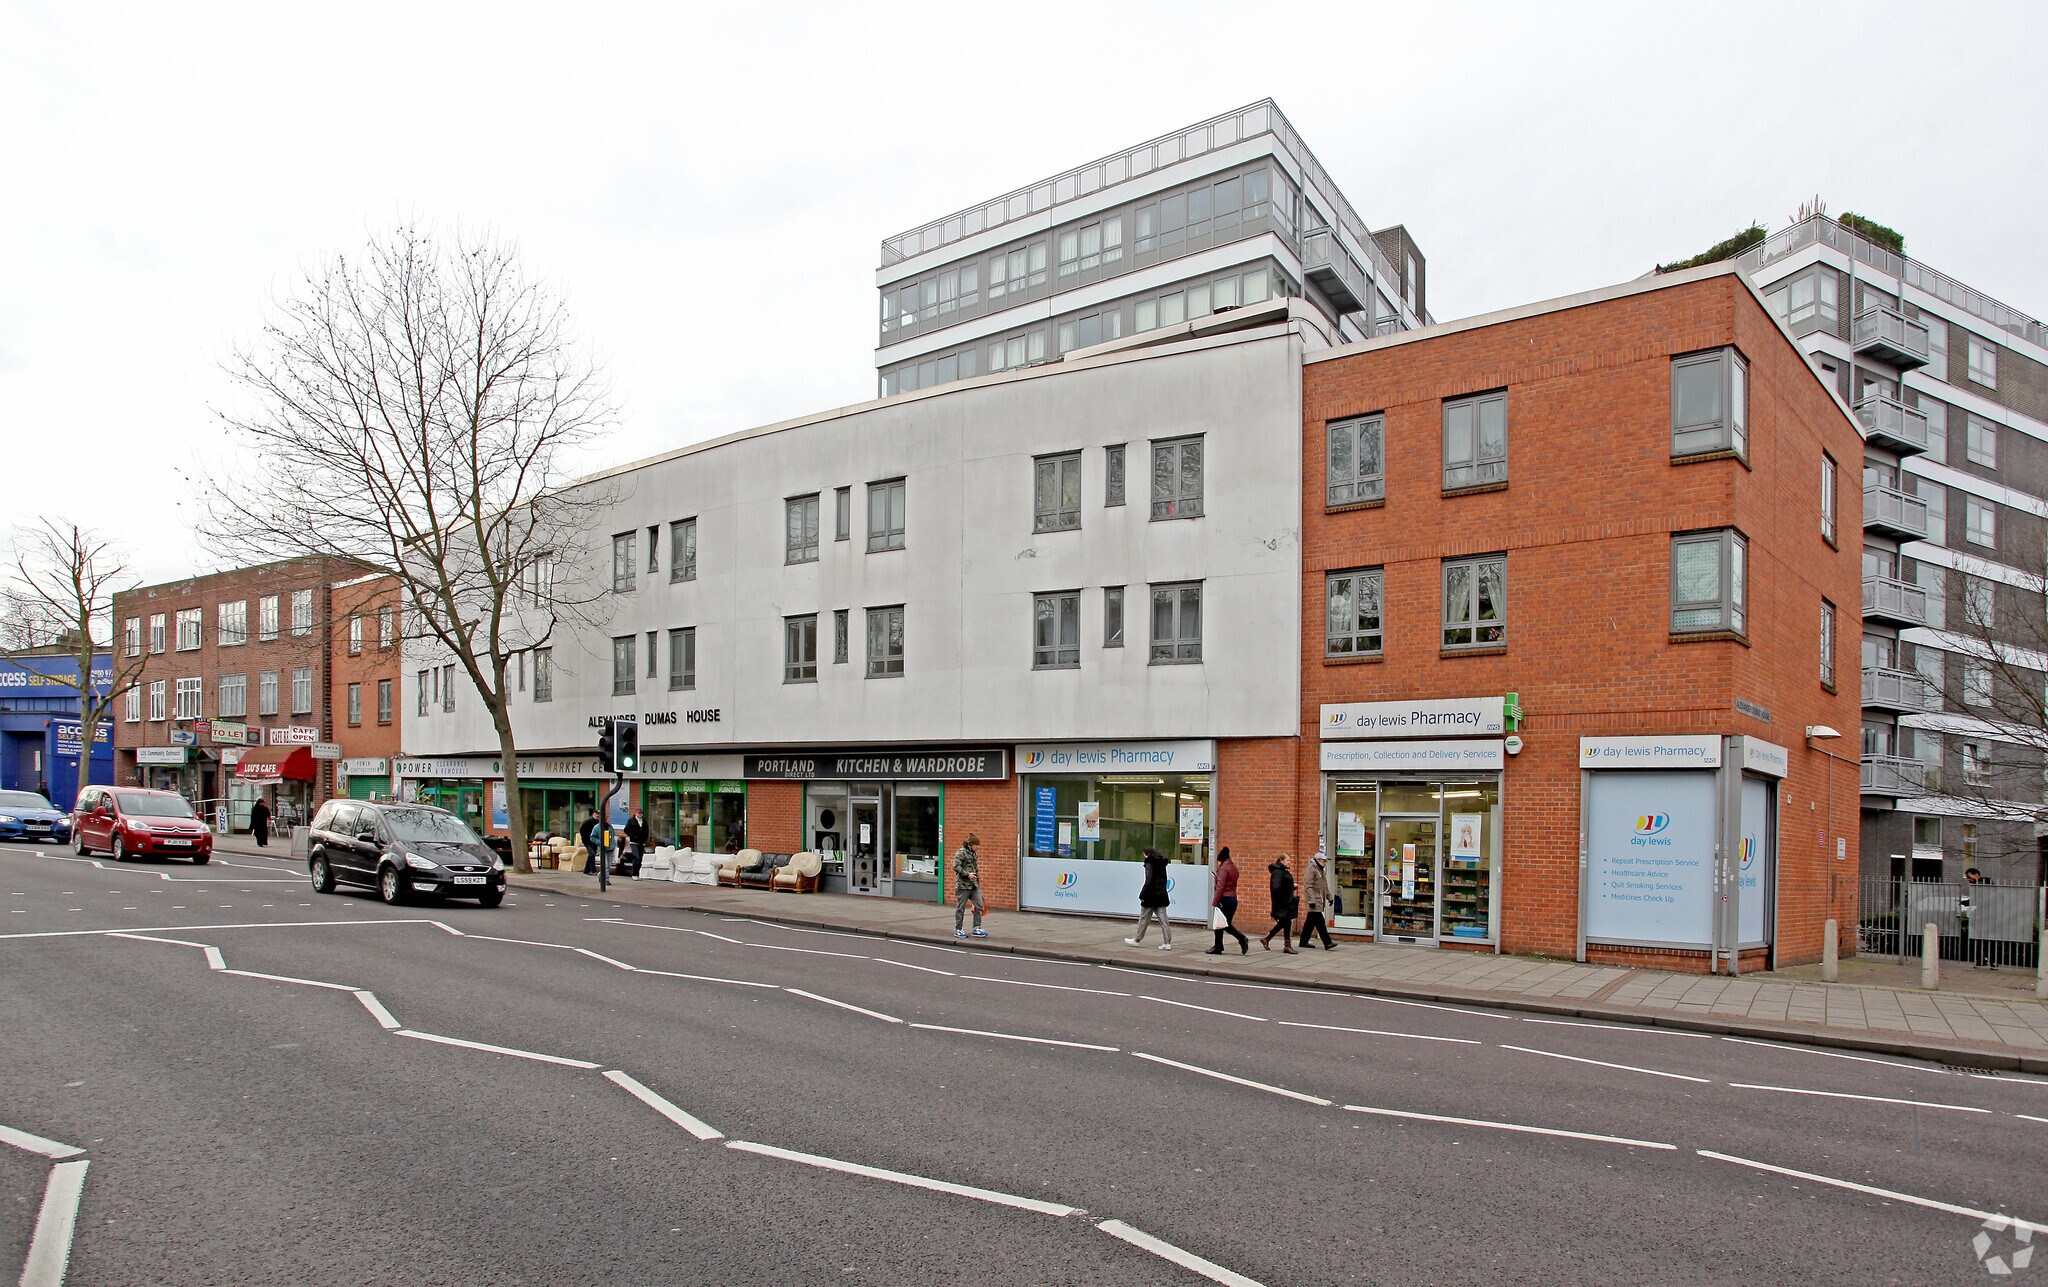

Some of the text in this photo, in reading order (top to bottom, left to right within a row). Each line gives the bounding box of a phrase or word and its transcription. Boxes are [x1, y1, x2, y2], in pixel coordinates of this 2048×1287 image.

[29, 675, 45, 686] SELF
[645, 712, 677, 725] DUMAS
[686, 709, 720, 723] HOUSE
[1356, 711, 1481, 729] day lewis Pharmacy
[58, 725, 108, 737] accss
[77, 735, 108, 743] SAGE
[1051, 749, 1175, 766] day lewis Pharmacy
[1327, 750, 1496, 760] Prescription, Collection and Delivery Services
[1604, 746, 1706, 758] day lewis Pharmacy
[244, 764, 276, 773] LOU'S CAFE
[403, 763, 432, 773] POWER
[502, 762, 535, 773] EEN
[545, 762, 582, 773] MARKET
[642, 760, 699, 773] LONDON
[757, 757, 985, 773] PORTLAND KITCHEN & WARDROBE
[1630, 836, 1671, 847] day lewis
[1635, 858, 1673, 866] Prescription
[1626, 882, 1653, 890] Smoking
[1655, 883, 1683, 891] Services
[1055, 890, 1064, 898] day
[1610, 893, 1641, 901] Medicines
[1643, 894, 1663, 902] Check
